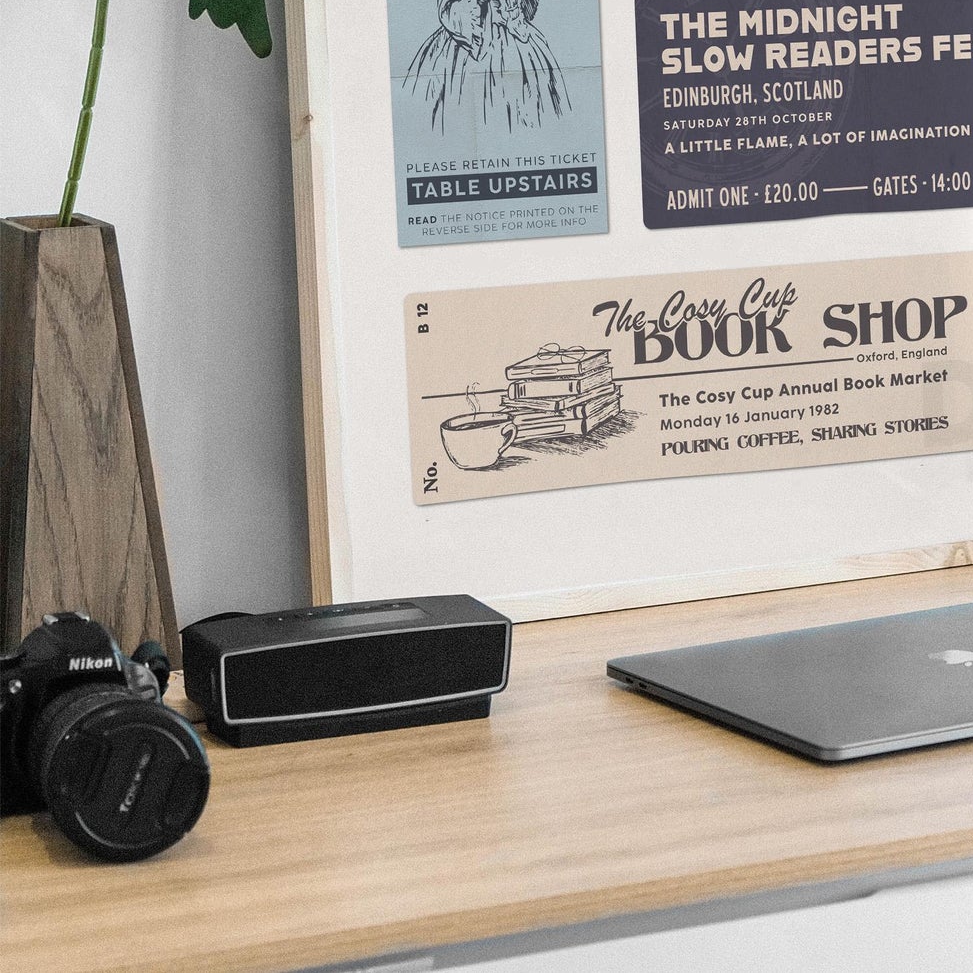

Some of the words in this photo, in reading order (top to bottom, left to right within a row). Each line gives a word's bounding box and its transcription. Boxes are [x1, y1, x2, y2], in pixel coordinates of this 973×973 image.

[660, 11, 727, 40] THE
[738, 4, 903, 37] MIDNIGHT
[662, 44, 754, 74] SLOW
[766, 37, 922, 69] READERS
[663, 84, 757, 108] EDINBURGH,
[764, 79, 843, 103] SCOTLAND
[664, 118, 730, 130] SATURDAY
[735, 115, 766, 126] 28TH
[773, 112, 832, 124] OCTOBER
[665, 143, 675, 154] A
[680, 139, 732, 153] LITTLE
[738, 136, 792, 150] FLAME,
[798, 135, 807, 146] A
[813, 132, 841, 145] LOT
[846, 131, 866, 143] OF
[871, 125, 970, 141] IMAGINATION
[407, 161, 456, 173] PLEASE
[463, 158, 509, 169] RETAIN
[515, 156, 545, 166] THIS
[550, 153, 596, 165] TICKET
[412, 179, 480, 198] TABLE
[489, 172, 592, 193] UPSTAIRS
[667, 188, 713, 210] ADMIT
[720, 186, 749, 207] ONE
[765, 181, 818, 204] £20.00
[873, 175, 917, 196] GATES
[932, 172, 970, 192] 14:00
[408, 216, 437, 225] READ
[441, 214, 462, 223] THE
[466, 211, 505, 222] NOTICE
[510, 208, 554, 219] PRINTED
[559, 207, 575, 216] ON
[579, 205, 598, 214] THE
[417, 303, 428, 317] 12
[592, 299, 646, 337] The
[659, 290, 727, 332] Cosy
[739, 278, 798, 319] Cup
[418, 324, 429, 333] B
[634, 310, 792, 364] BOOK
[823, 295, 968, 349] SHOP
[857, 351, 898, 363] Oxford,
[901, 347, 947, 360] England
[659, 394, 690, 407] The
[696, 390, 735, 404] Cosy
[741, 387, 773, 400] Cup
[779, 379, 837, 396] Annual
[844, 378, 885, 391] Book
[890, 370, 948, 386] Market
[660, 416, 721, 431] Monday
[726, 414, 739, 424] 16
[745, 408, 805, 422] January
[810, 404, 839, 416] 1982
[662, 437, 729, 456] POURING
[737, 431, 803, 448] COFFEE,
[811, 424, 877, 442] SHARING
[884, 416, 949, 435] STORIES
[424, 462, 438, 493] No.
[69, 658, 112, 671] Nikon
